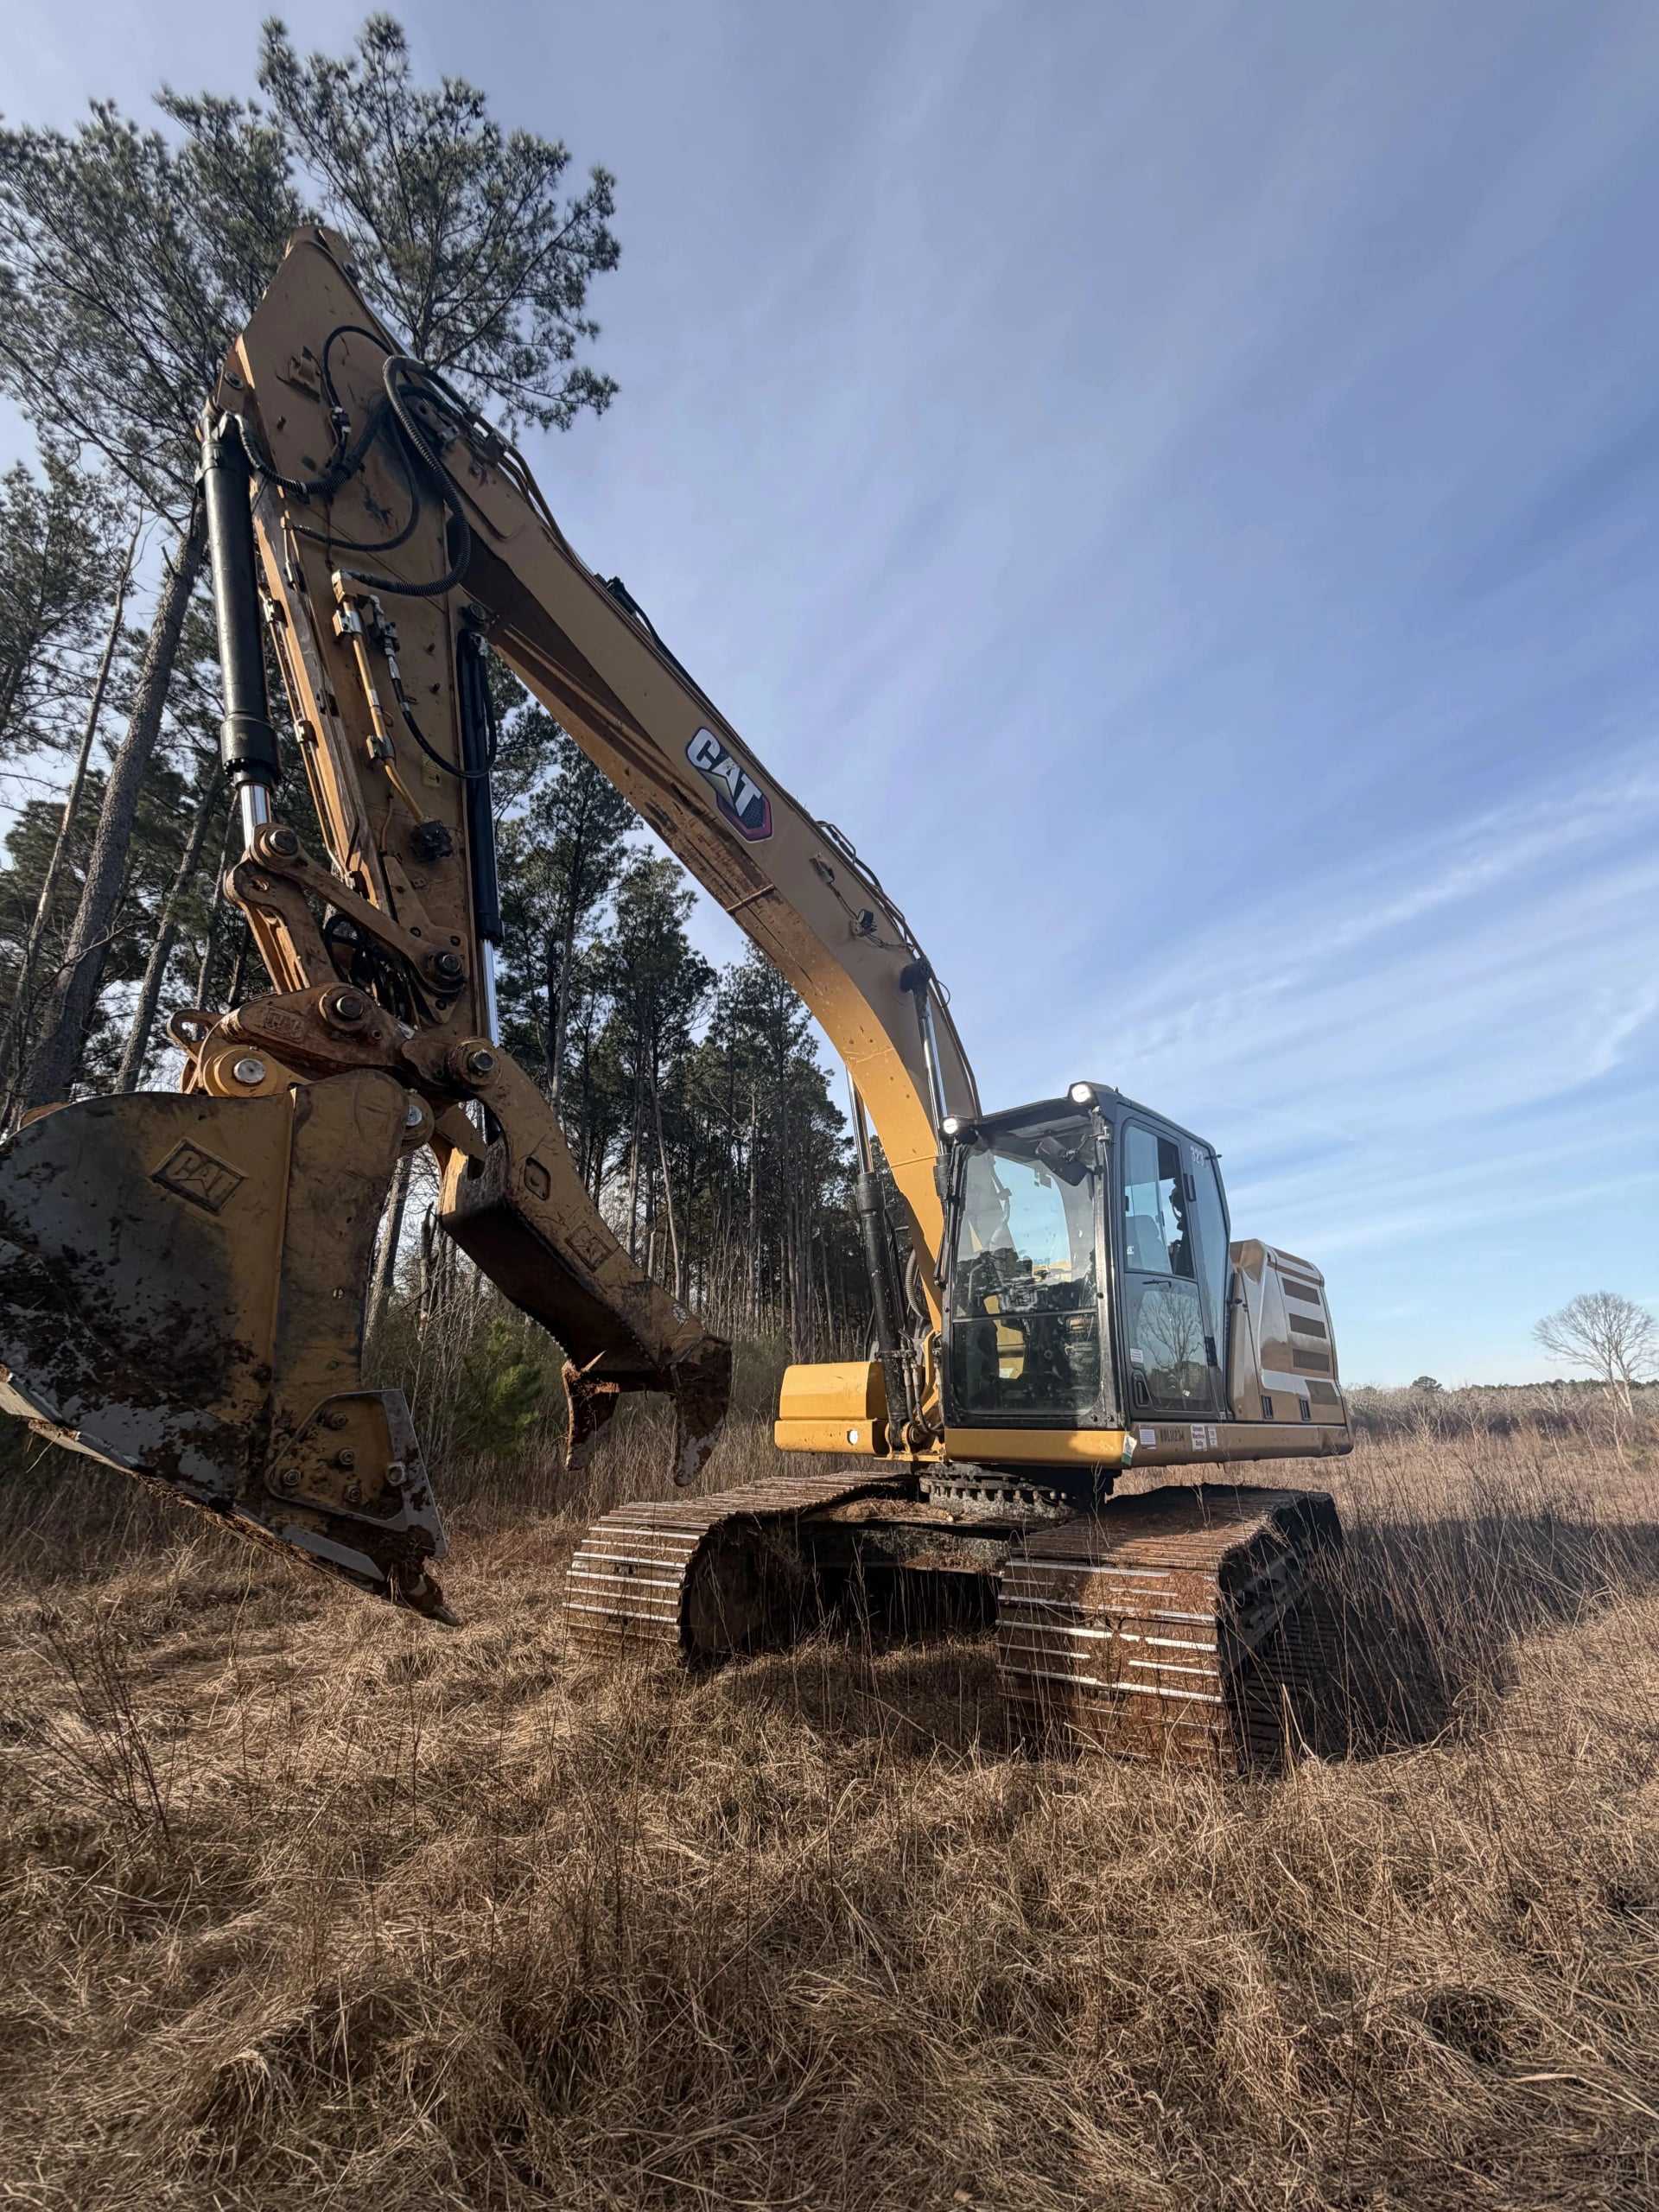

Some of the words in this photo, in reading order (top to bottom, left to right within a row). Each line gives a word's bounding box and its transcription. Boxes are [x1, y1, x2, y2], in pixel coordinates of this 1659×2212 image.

[687, 728, 762, 817] CAT
[165, 1150, 240, 1204] CAT
[1190, 1146, 1205, 1166] 323
